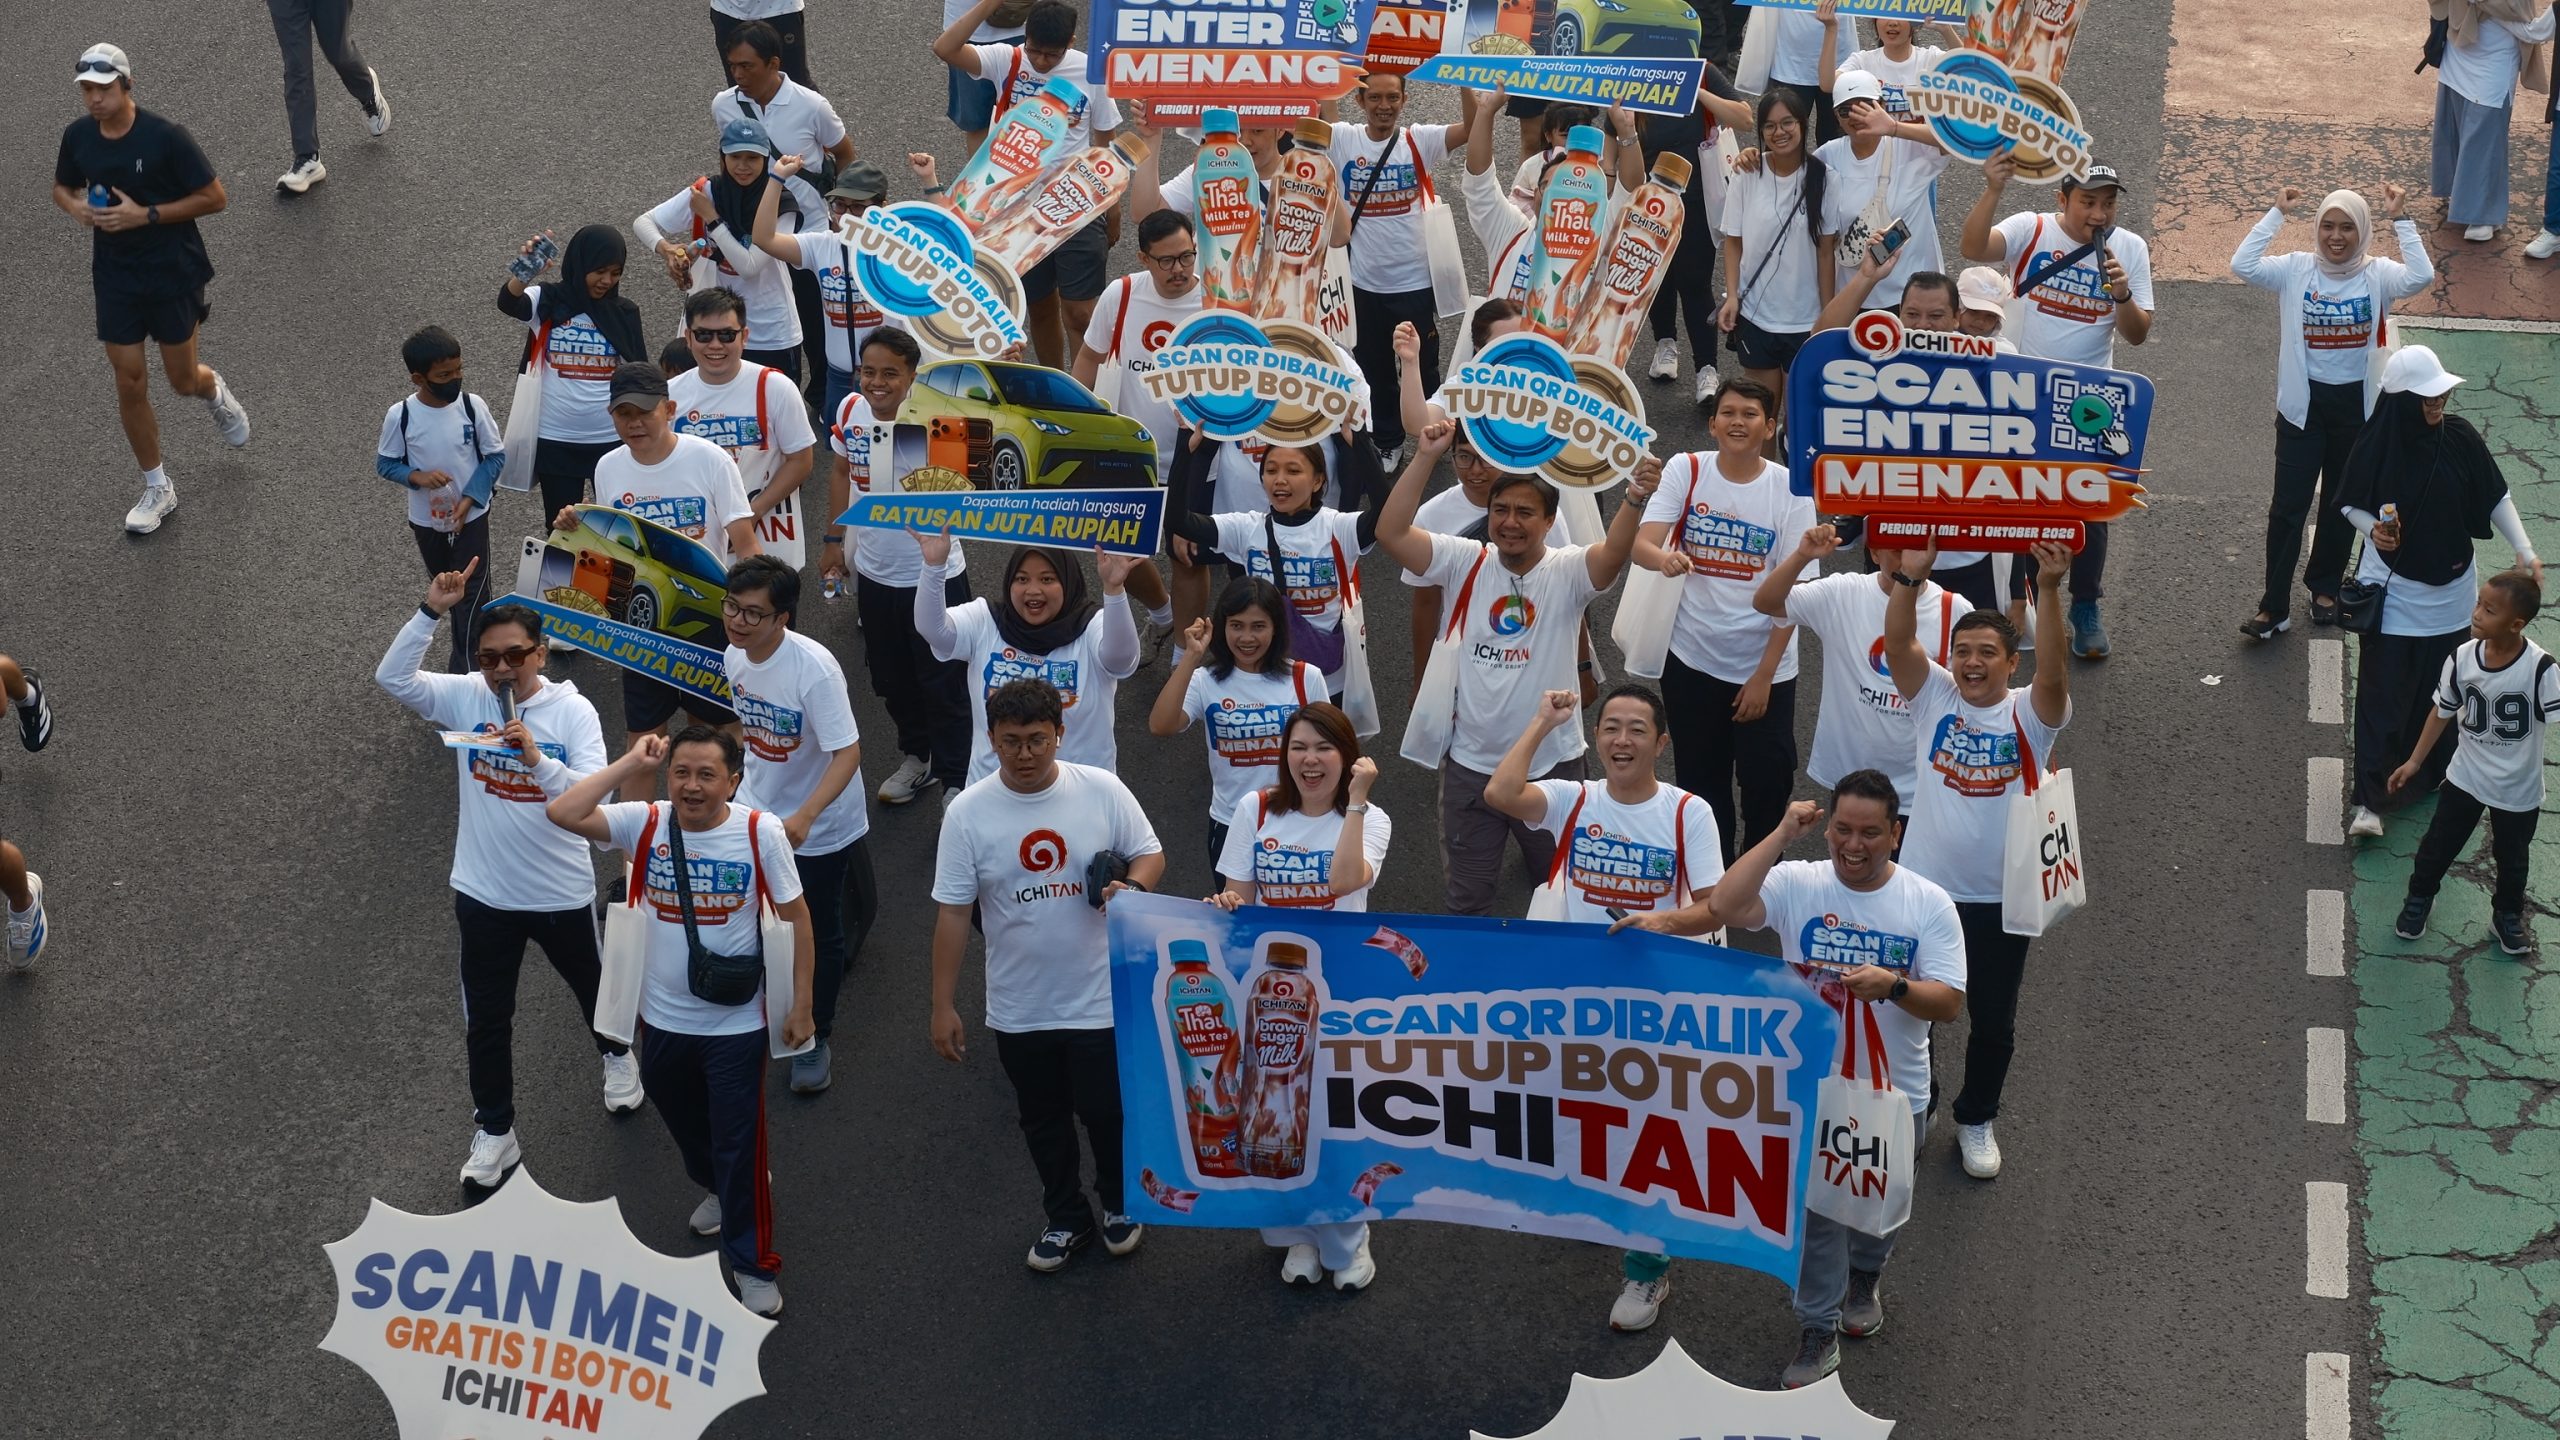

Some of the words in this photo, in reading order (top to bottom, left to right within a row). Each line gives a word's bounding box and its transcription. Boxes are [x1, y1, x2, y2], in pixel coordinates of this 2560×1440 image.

[1905, 0, 1966, 17] RUPIA
[1116, 9, 1285, 45] ENTER
[1114, 53, 1340, 84] MENANG
[1380, 54, 1421, 66] OKTOBER
[1521, 59, 1581, 74] Dapatkan
[1584, 62, 1626, 77] hadiah
[1629, 65, 1687, 85] langsung
[1436, 64, 1543, 90] RATUSAN
[1541, 76, 1595, 97] JUTA
[1597, 79, 1681, 107] RUPIAH
[1028, 110, 1054, 129] ICHITAN
[1155, 104, 1193, 115] PERIODE
[1239, 105, 1281, 116] OKTOBER
[1284, 105, 1310, 116] 2026
[1920, 74, 1976, 96] SCAN
[1980, 86, 2008, 106] QR
[2010, 97, 2088, 150] DIBALIK
[1006, 121, 1041, 158] Thai
[1907, 91, 1998, 124] TUTUP
[2001, 111, 2089, 179] BOTOL
[993, 142, 1015, 160] Milk
[1018, 154, 1035, 169] Tea
[1207, 160, 1239, 168] ICHITAN
[1075, 162, 1109, 196] ICHITAN
[1562, 178, 1592, 190] ICHITAN
[2088, 165, 2118, 177] CHITAN
[1053, 184, 1083, 215] sugar
[1060, 174, 1094, 213] brown
[1204, 180, 1246, 209] Thai
[1281, 179, 1326, 197] ICHITAN
[1034, 193, 1071, 227] Milk
[1205, 210, 1229, 223] Milk
[1232, 209, 1250, 219] Tea
[1280, 199, 1325, 224] brown
[1552, 201, 1591, 231] Thai
[1279, 214, 1317, 233] sugar
[1628, 211, 1669, 238] ICHITAN
[1275, 229, 1313, 256] Milk
[1545, 232, 1569, 243] Milk
[1572, 235, 1590, 245] Tea
[1620, 232, 1662, 267] brown
[1615, 249, 1652, 272] sugar
[845, 219, 939, 281] TUTUP
[933, 279, 1004, 360] BOTO
[867, 210, 929, 252] SCAN
[928, 247, 958, 274] QR
[955, 268, 1023, 345] DIBALIK
[1604, 264, 1645, 296] Milk
[2032, 287, 2108, 312] MENANG
[2303, 300, 2354, 315] SCAN
[549, 340, 606, 356] ENTER
[551, 327, 607, 344] SCAN
[1905, 332, 1995, 358] ICHITAN
[1156, 348, 1222, 369] SCAN
[1226, 348, 1259, 368] QR
[1263, 352, 1356, 394] DIBALIK
[1144, 368, 1251, 398] TUTUP
[1257, 371, 1360, 426] BOTOL
[1821, 358, 2036, 411] SCAN
[1444, 387, 1549, 423] TUTUP
[1461, 367, 1527, 390] SCAN
[1529, 376, 1562, 400] QR
[1563, 388, 1650, 448] DIBALIK
[681, 420, 738, 437] SCAN
[1821, 407, 2037, 455] ENTER
[1823, 460, 2110, 503] MENANG
[962, 496, 1028, 510] Dapatkan
[1031, 497, 1079, 512] hadiah
[1081, 501, 1147, 518] langsung
[869, 504, 984, 531] RATUSAN
[985, 514, 1047, 537] JUTA
[1050, 517, 1142, 545] RUPIAH
[1686, 514, 1745, 537] SCAN
[1879, 522, 1929, 536] PERIODE
[1938, 525, 1959, 537] MEI
[1970, 525, 1982, 538] 31
[1985, 525, 2038, 539] OKTOBER
[2041, 527, 2075, 540] 2026
[1684, 529, 1744, 551] ENTER
[534, 610, 614, 652] TUSAN
[613, 640, 669, 675] JUTA
[671, 662, 733, 701] RUPIA
[596, 621, 656, 650] Dapatkan
[657, 641, 701, 664] hadiah
[702, 655, 728, 676] lang
[1474, 643, 1529, 662] ICHITAN
[1213, 711, 1279, 726] SCAN
[2462, 683, 2532, 742] 09
[1216, 723, 1281, 740] ENTER
[1279, 844, 1309, 853] ICHITAN
[1574, 836, 1643, 863] SCAN
[1603, 831, 1631, 844] ICHITAN
[1256, 851, 1319, 870] SCAN
[1573, 853, 1642, 878] ENTER
[1257, 868, 1320, 885] ENTER
[1573, 870, 1665, 894] MENANG
[1016, 882, 1083, 904] ICHITAN
[1813, 927, 1880, 950] SCAN
[1811, 943, 1880, 965] ENTER
[1177, 1007, 1223, 1031] Thai
[1259, 1001, 1306, 1011] ICHITAN
[1183, 1034, 1207, 1045] Milk
[1209, 1032, 1228, 1041] Tea
[1259, 1019, 1307, 1034] brown
[1259, 1032, 1301, 1044] sugar
[1320, 1003, 1482, 1036] SCAN
[1486, 1001, 1570, 1040] QR
[1576, 998, 1791, 1056] DIBALIK
[1257, 1043, 1297, 1067] Milk
[1320, 1040, 1552, 1084] TUTUP
[1561, 1044, 1792, 1126] BOTOL
[1328, 1078, 1791, 1237] ICHITAN
[1819, 1119, 1888, 1171] ICHI
[1818, 1151, 1888, 1200] TAN
[352, 1248, 563, 1331] SCAN
[569, 1269, 724, 1387] ME!!
[385, 1316, 525, 1370] GRATIS
[533, 1337, 548, 1374] 1
[551, 1341, 672, 1410] BOTOL
[442, 1365, 604, 1434] ICHITAN
